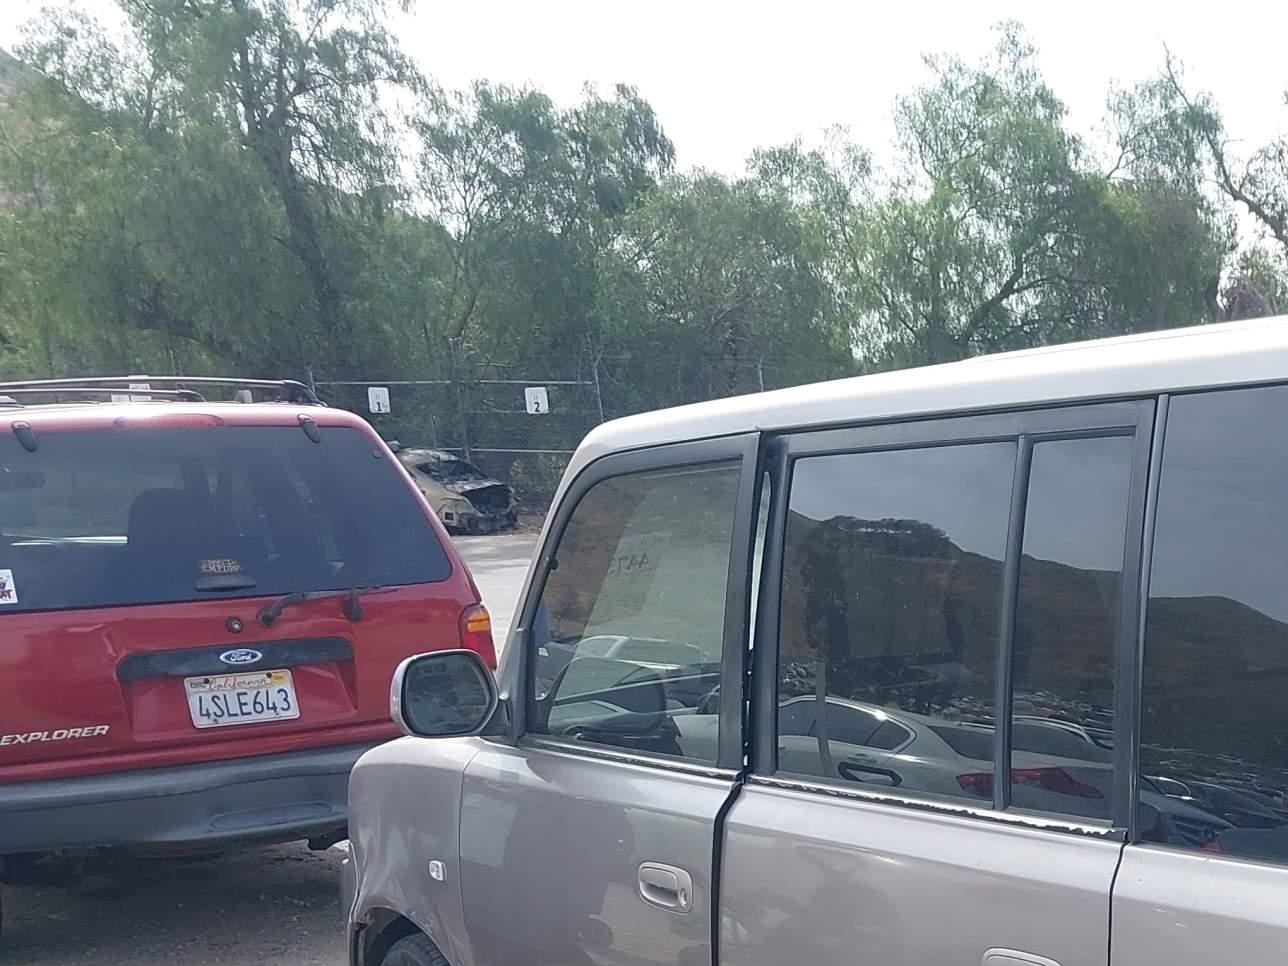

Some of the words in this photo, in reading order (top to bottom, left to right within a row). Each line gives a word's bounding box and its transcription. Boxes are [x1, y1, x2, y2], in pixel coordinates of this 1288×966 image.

[533, 401, 541, 413] 2
[229, 650, 253, 662] Ford
[198, 688, 291, 719] 4SLE643
[0, 725, 110, 746] EXPLORER
